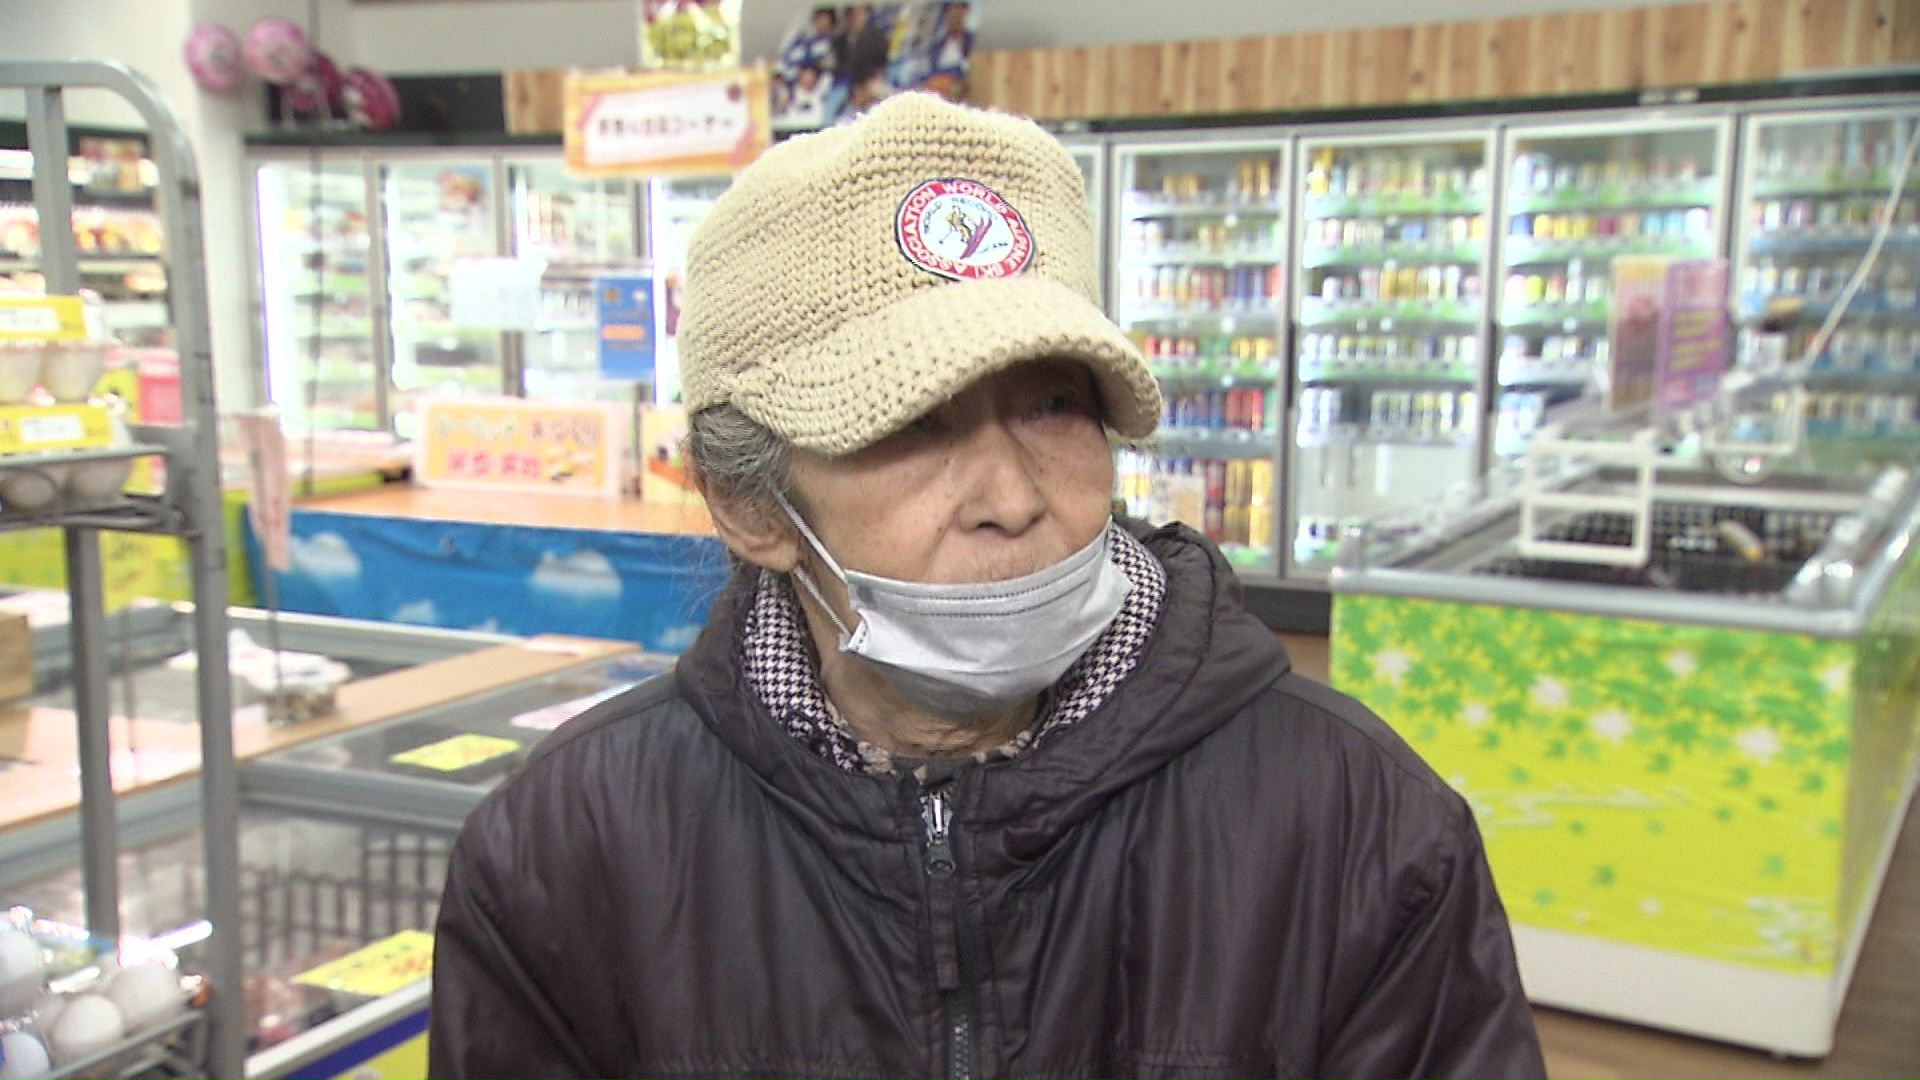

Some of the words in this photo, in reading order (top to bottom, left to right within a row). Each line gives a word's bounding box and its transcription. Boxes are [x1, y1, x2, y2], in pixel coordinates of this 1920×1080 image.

[942, 181, 1008, 214] WORLD
[904, 186, 969, 274] ASSOCIATION
[974, 265, 1005, 277] SKI
